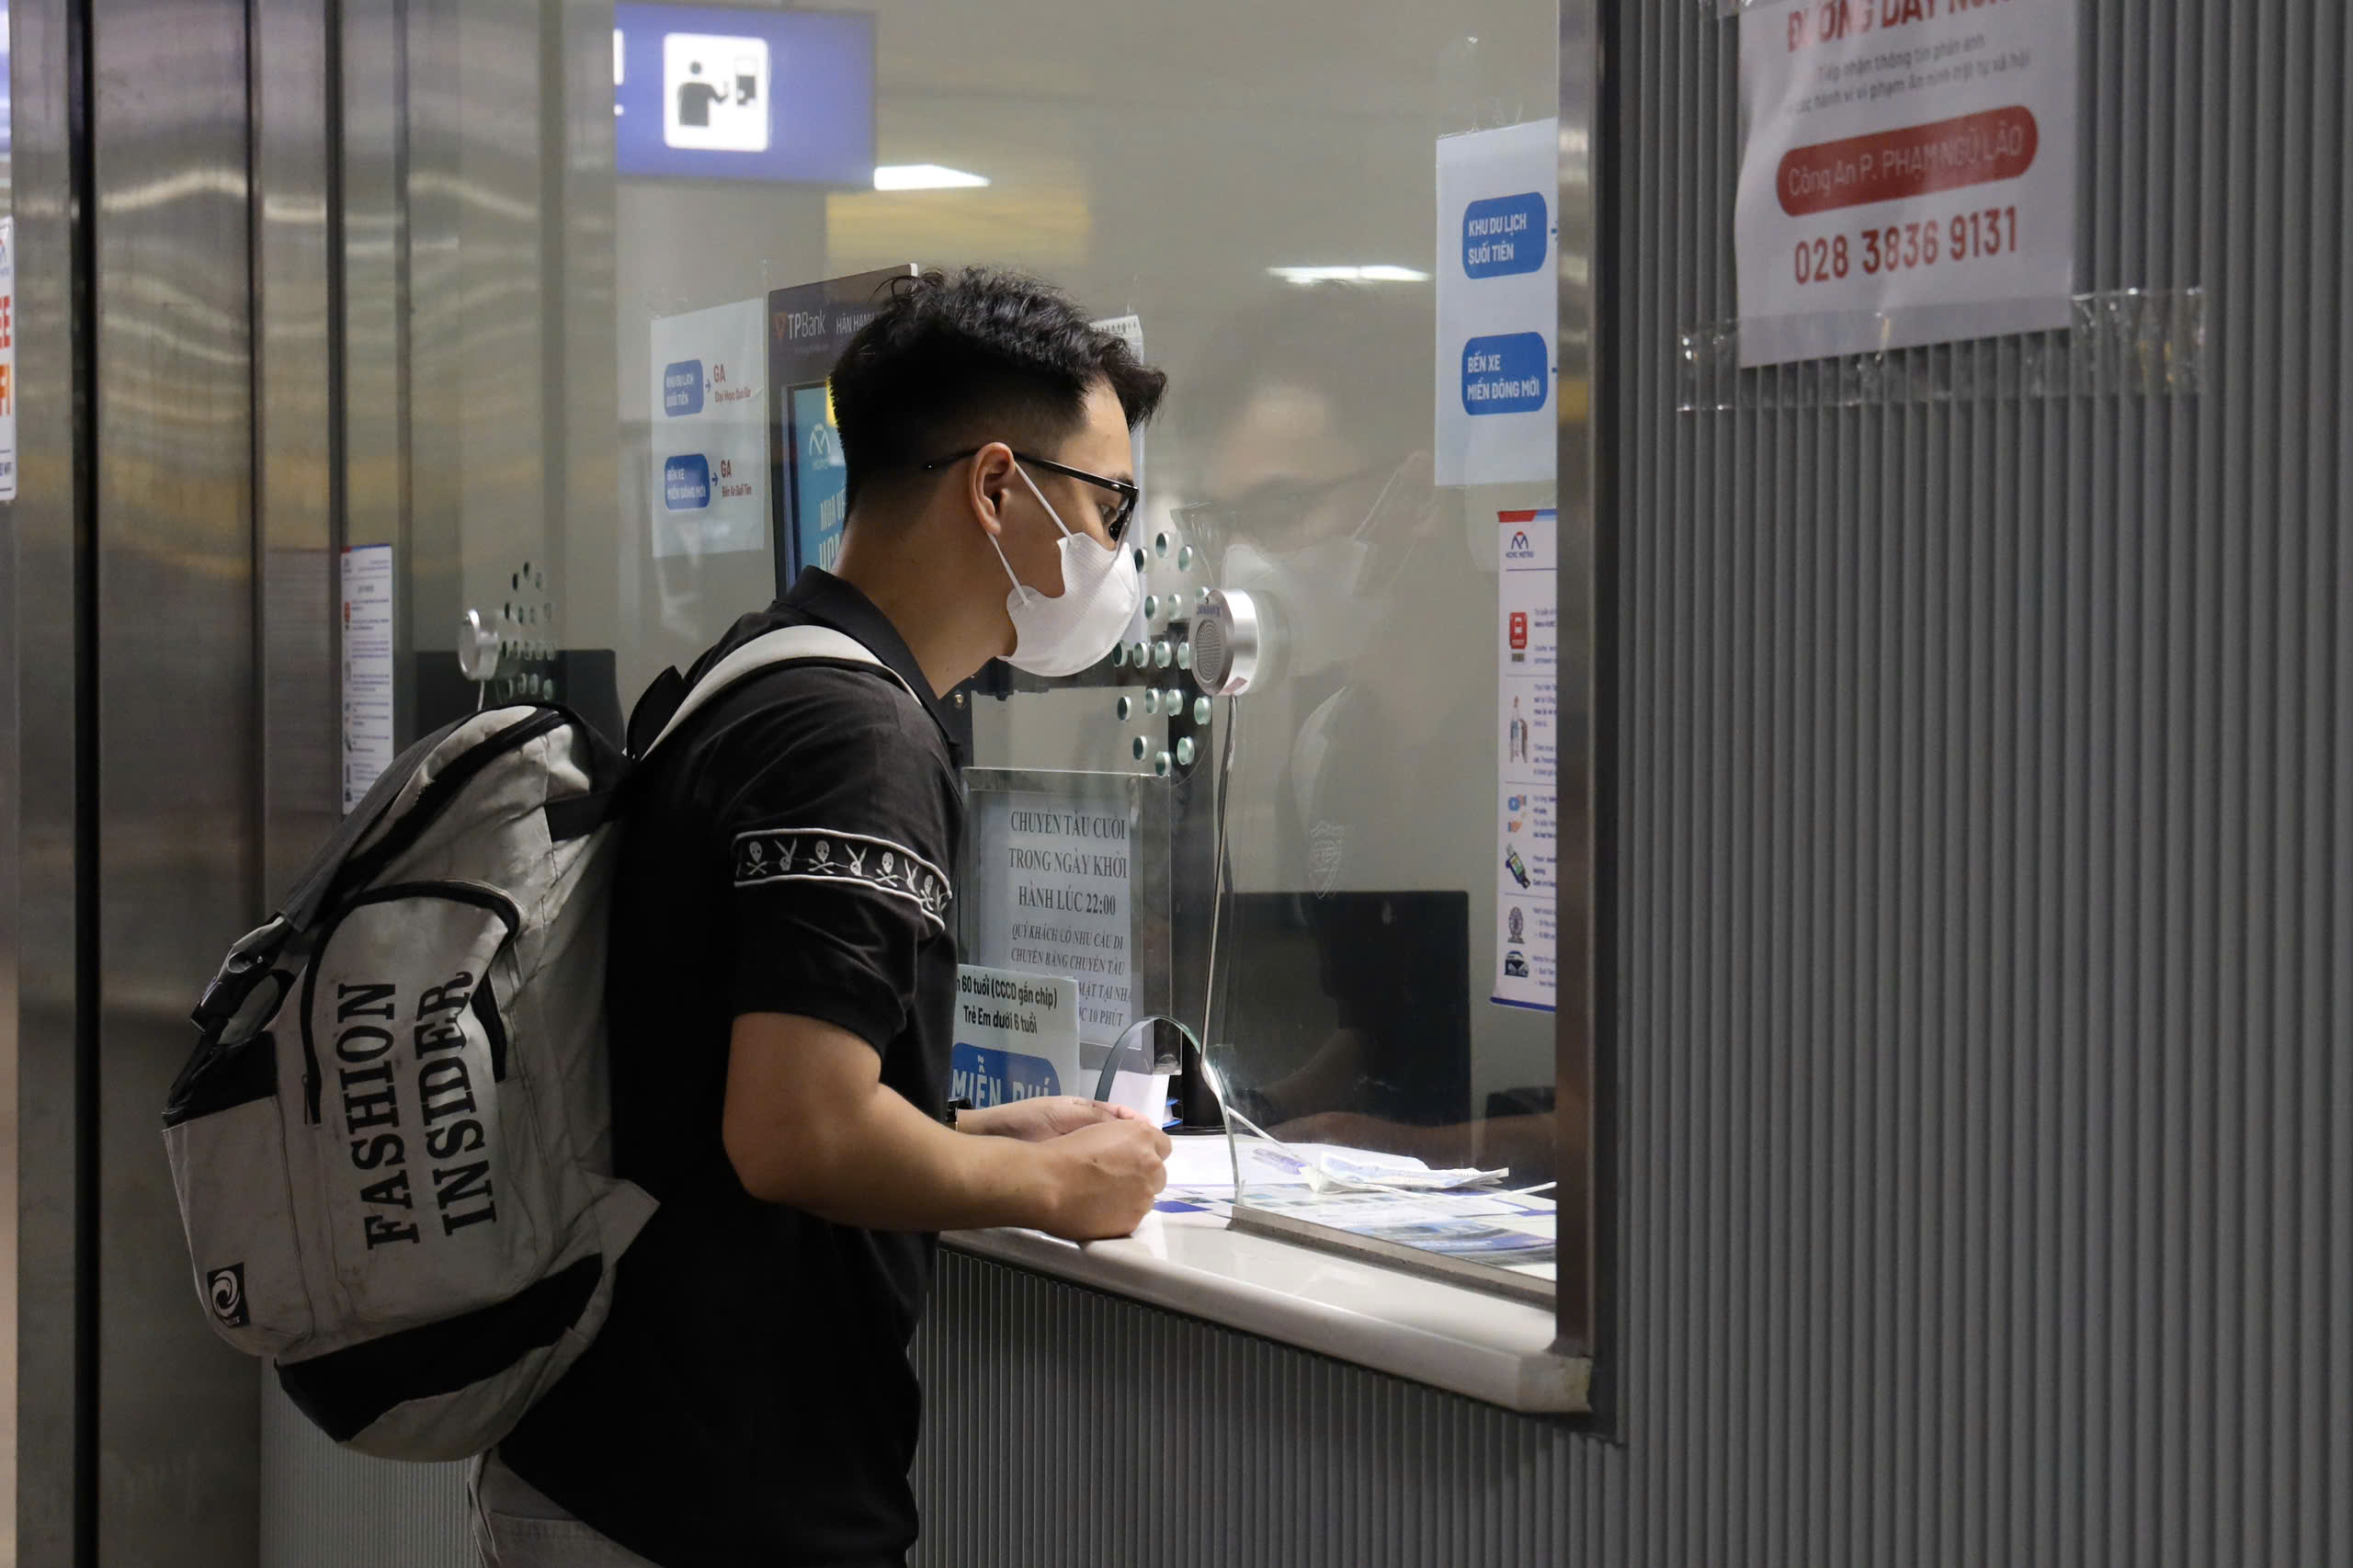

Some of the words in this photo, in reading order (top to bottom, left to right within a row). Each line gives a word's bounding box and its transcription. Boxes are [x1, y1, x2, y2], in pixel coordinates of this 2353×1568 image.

[1788, 165, 1831, 198] Công
[1860, 153, 1878, 181] P.
[1469, 219, 1489, 236] KHU
[1490, 216, 1503, 234] DU
[1504, 212, 1527, 236] LỊCH
[1468, 240, 1491, 265] SUỐI
[1492, 240, 1514, 262] TIÊN
[1794, 234, 1849, 285] 028
[1861, 220, 1939, 275] 3836
[1949, 205, 2018, 261] 9131
[788, 309, 826, 340] TPBank
[713, 364, 726, 383] GA
[1468, 350, 1486, 373] BẾN
[1487, 354, 1501, 371] XE
[1492, 378, 1519, 400] ĐÔNG
[721, 460, 733, 478] GA
[1064, 809, 1090, 837] TÀU
[1008, 847, 1051, 872] TRONG
[1053, 846, 1090, 875] NGÀY
[1018, 881, 1053, 909] HÀNH
[1057, 884, 1083, 913] LÚC
[1086, 892, 1116, 915] 22:00
[1012, 921, 1029, 940] QUÝ
[1029, 923, 1058, 942] KHÁCH
[1060, 926, 1072, 943] CÓ
[961, 974, 972, 993] 60
[973, 974, 990, 996] tuổi
[991, 978, 1017, 1000] (CCCD
[1018, 981, 1034, 1006] gắn
[1035, 987, 1058, 1010] chip)
[1098, 984, 1113, 1003] TẠI
[963, 1005, 977, 1024] Trẻ
[978, 1006, 991, 1027] Em
[993, 1010, 1013, 1030] dưới
[1014, 1013, 1020, 1031] 6
[1020, 1012, 1038, 1034] tuổi
[1089, 1007, 1098, 1022] 10
[1100, 1008, 1124, 1027] PHÚT
[336, 983, 421, 1250] FASHION
[415, 971, 497, 1236] INSIDER
